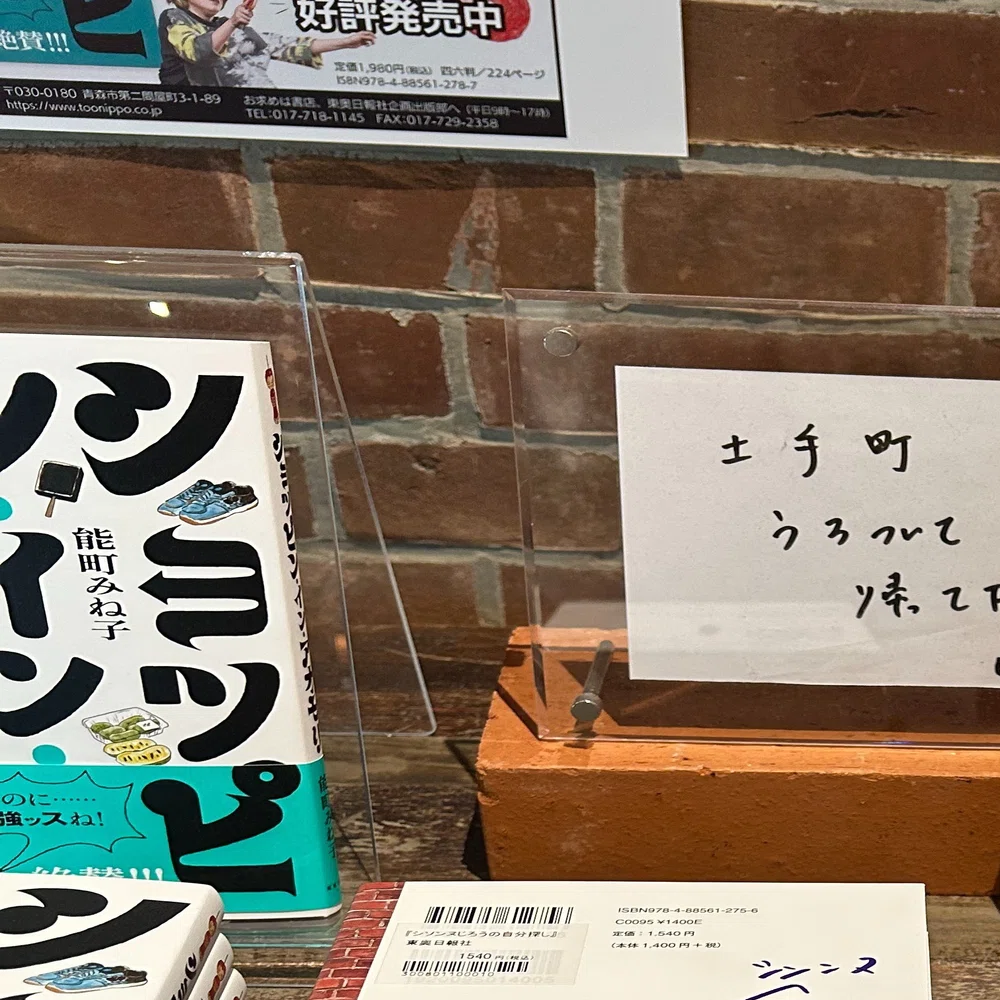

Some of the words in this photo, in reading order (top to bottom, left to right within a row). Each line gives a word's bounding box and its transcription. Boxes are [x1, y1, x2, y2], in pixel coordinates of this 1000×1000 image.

[296, 0, 505, 38] 好評発売中
[6, 99, 163, 118] https://www.toonippo.co.jp
[720, 422, 912, 478] 土手町
[772, 509, 962, 550] うろついて
[72, 526, 131, 641] 能町みね子
[617, 906, 760, 914] ISBN978-4-88561-275-6
